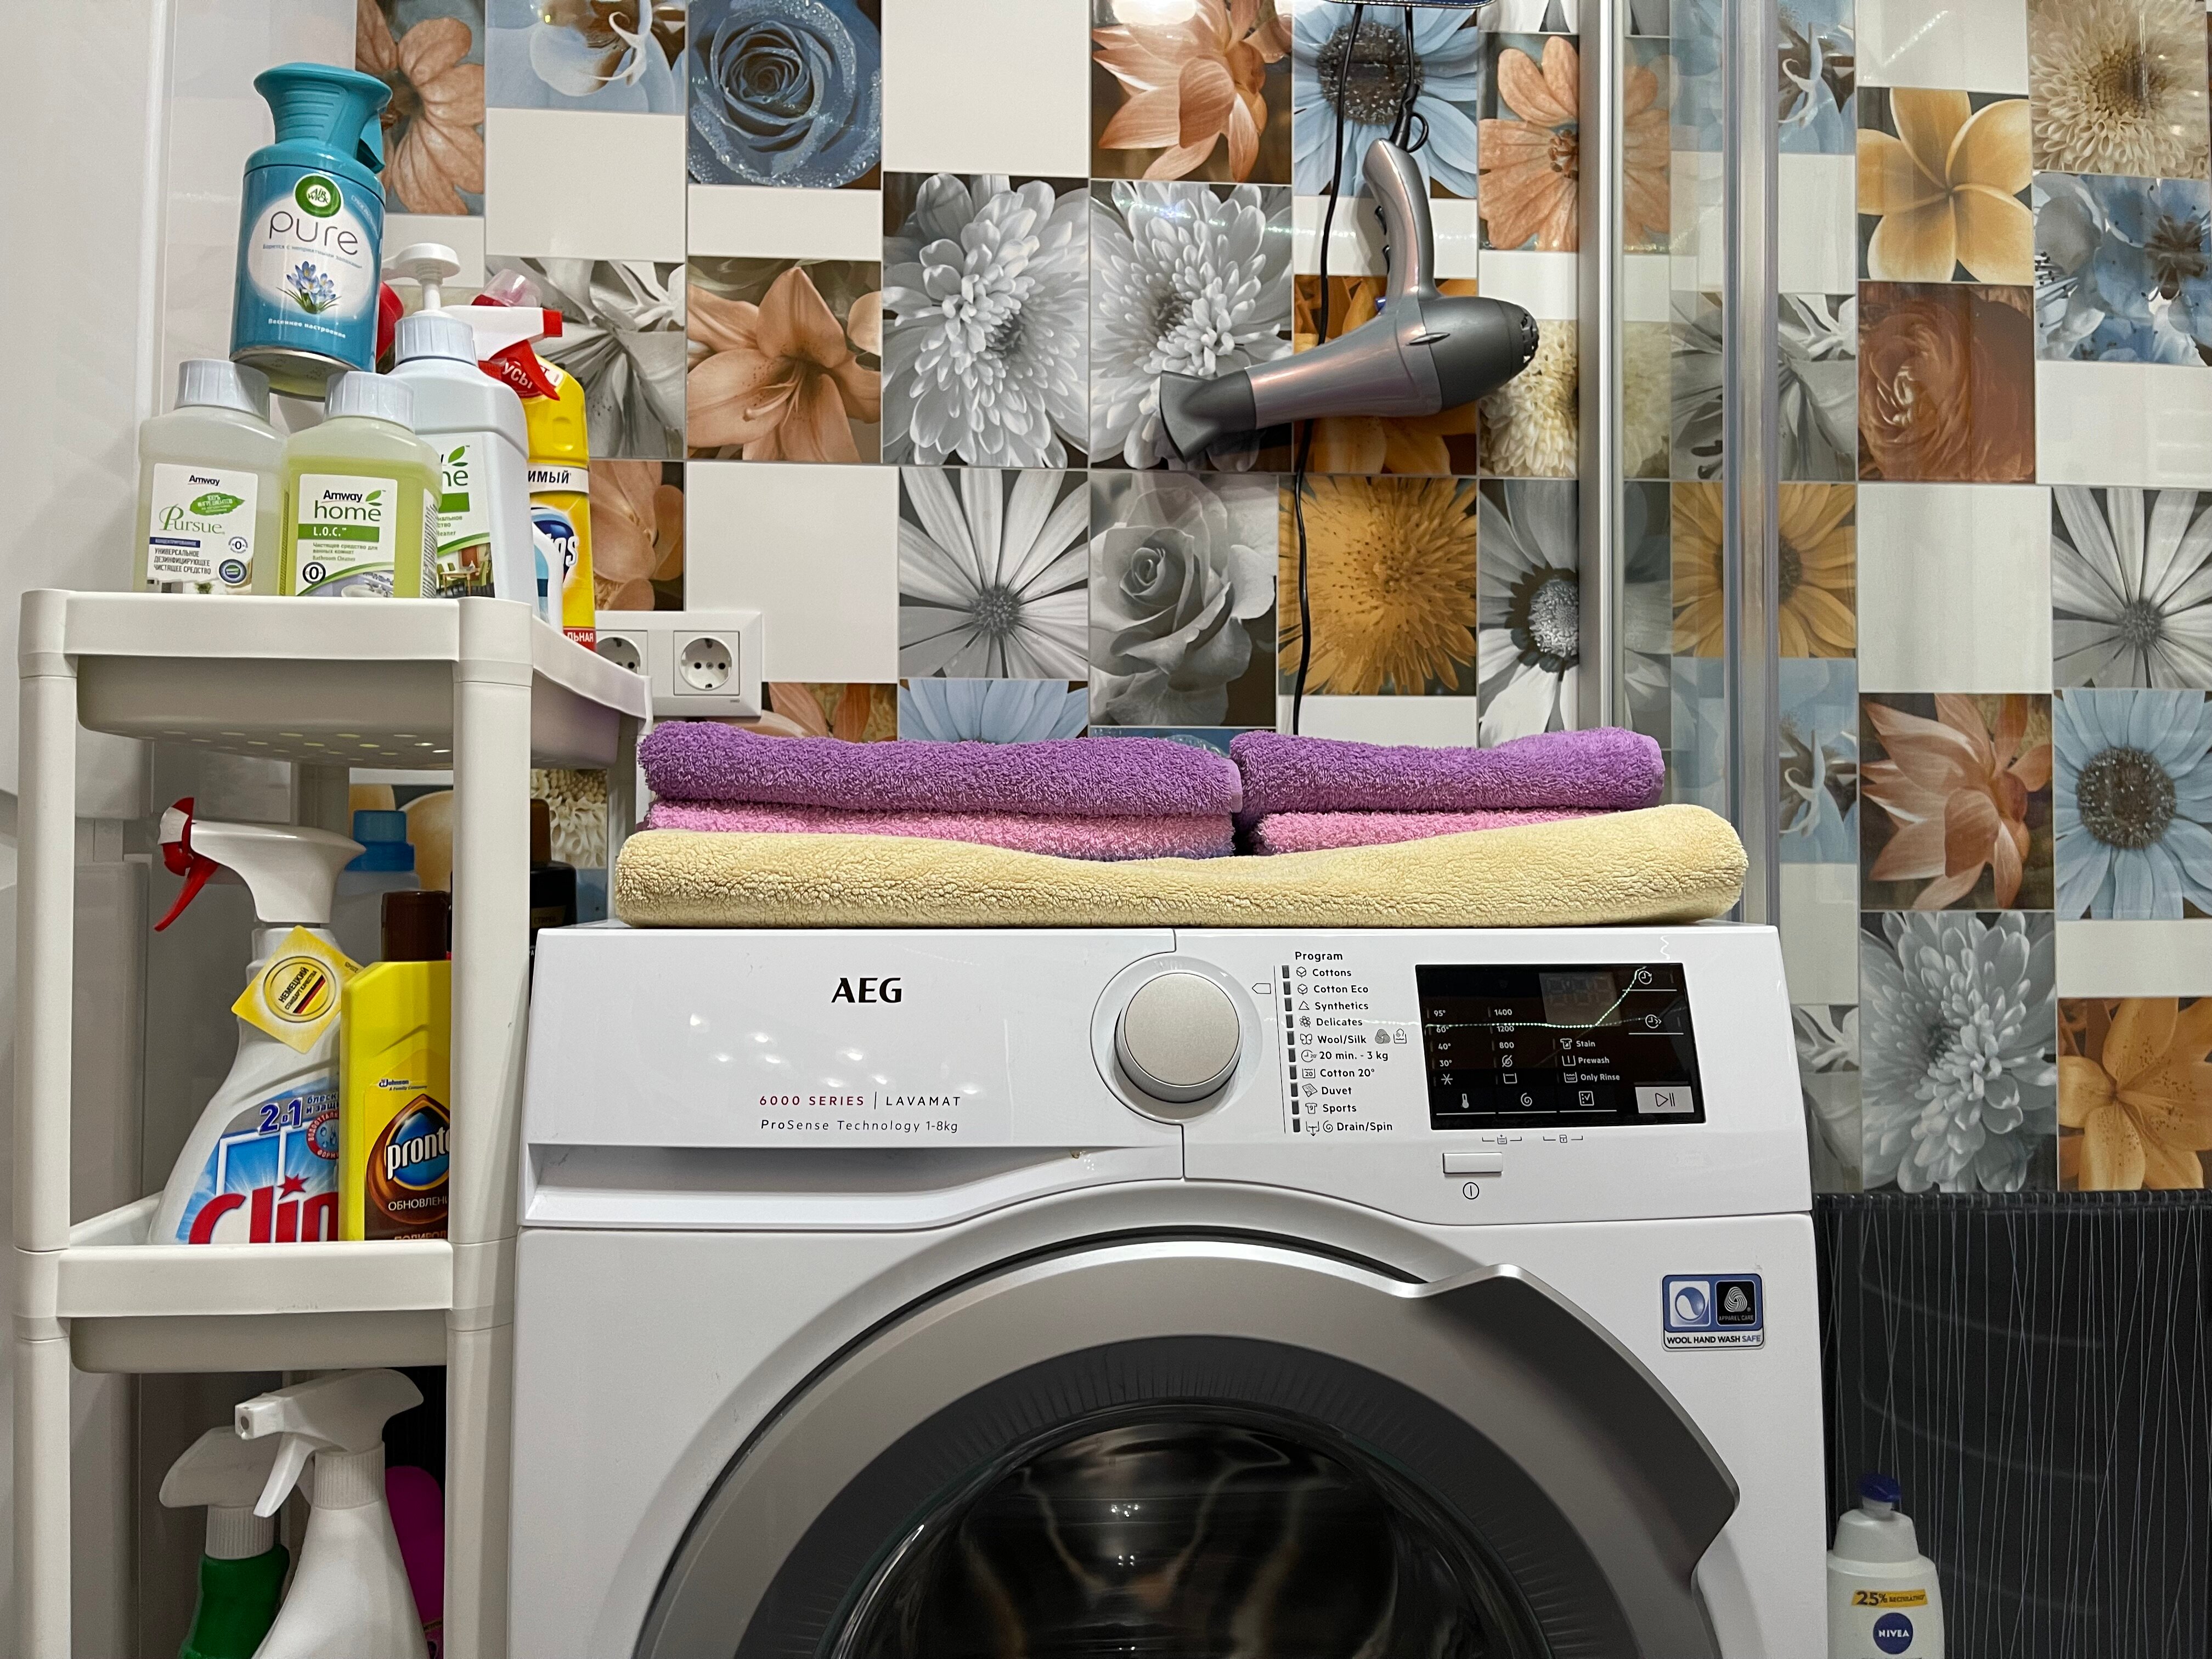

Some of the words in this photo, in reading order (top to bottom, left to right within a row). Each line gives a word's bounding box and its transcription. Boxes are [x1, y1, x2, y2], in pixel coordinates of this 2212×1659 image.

[269, 211, 358, 255] pure
[189, 475, 220, 486] Amway
[528, 470, 569, 483] ИМЫЙ
[323, 490, 363, 503] Amway
[314, 500, 381, 521] home
[159, 504, 222, 534] Pursue
[155, 547, 199, 557] УНИВЕРСАЛЬНОЕ
[183, 566, 211, 574] СРЕДСТВО
[567, 631, 594, 642] ЛЬНАЯ
[1295, 952, 1343, 962] Program
[1312, 969, 1352, 977] Cottons
[278, 966, 309, 1003] НЕМЕЦКИЙ
[831, 977, 902, 1003] AEG
[1314, 1002, 1369, 1011] Synthetics
[1316, 1018, 1363, 1026] Delicates
[1317, 1035, 1367, 1044] Wool/Silk
[1319, 1051, 1332, 1059] 20
[1335, 1051, 1357, 1059] min.
[1376, 1051, 1389, 1061] kg
[1320, 1069, 1355, 1077] Cotton
[1581, 1074, 1598, 1082] Only
[1322, 1086, 1352, 1095] Duvet
[759, 1095, 800, 1106] 6000
[809, 1095, 865, 1106] SERIES
[886, 1096, 961, 1106] LAVAMAT
[1323, 1104, 1357, 1114] Sports
[761, 1120, 830, 1131] ProSense
[837, 1120, 920, 1133] Technology
[926, 1121, 958, 1133] 1-8kg
[1337, 1122, 1393, 1132] Drain/Spin
[1856, 1591, 1888, 1606] 25%
[1878, 1629, 1910, 1638] NIVEA
